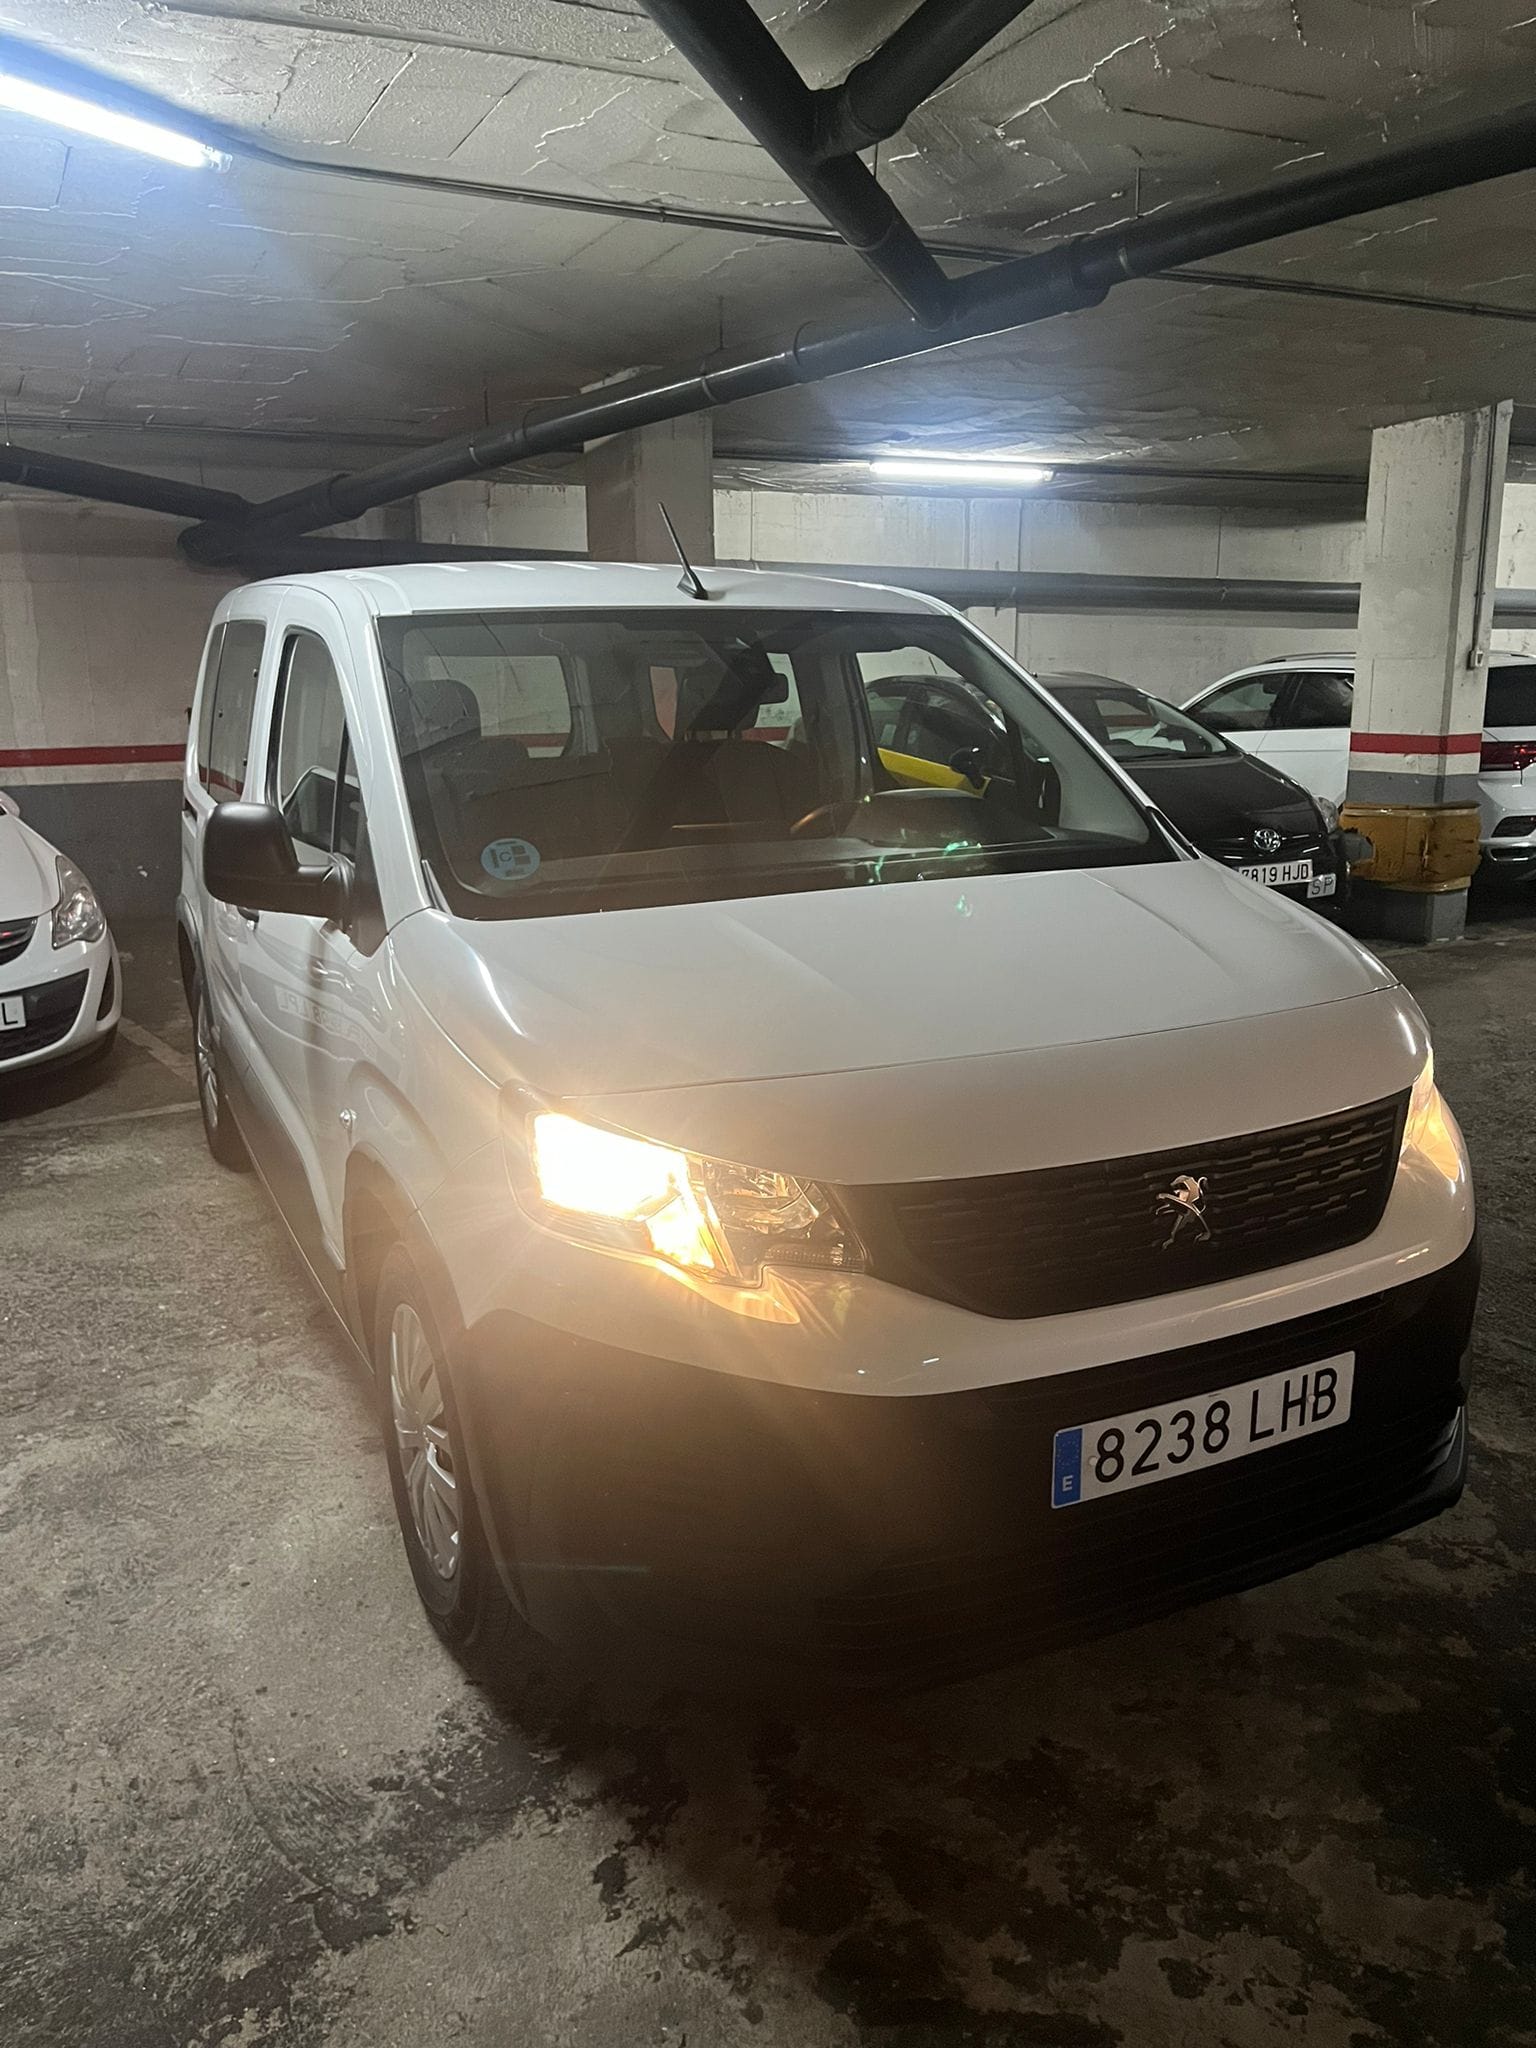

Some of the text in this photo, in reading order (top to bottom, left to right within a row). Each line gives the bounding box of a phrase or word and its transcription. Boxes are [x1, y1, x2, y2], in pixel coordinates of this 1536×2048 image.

[1282, 863, 1309, 882] HJD
[1312, 876, 1333, 896] SP
[1095, 1367, 1338, 1483] 8238 LHB
[1062, 1475, 1074, 1492] E
